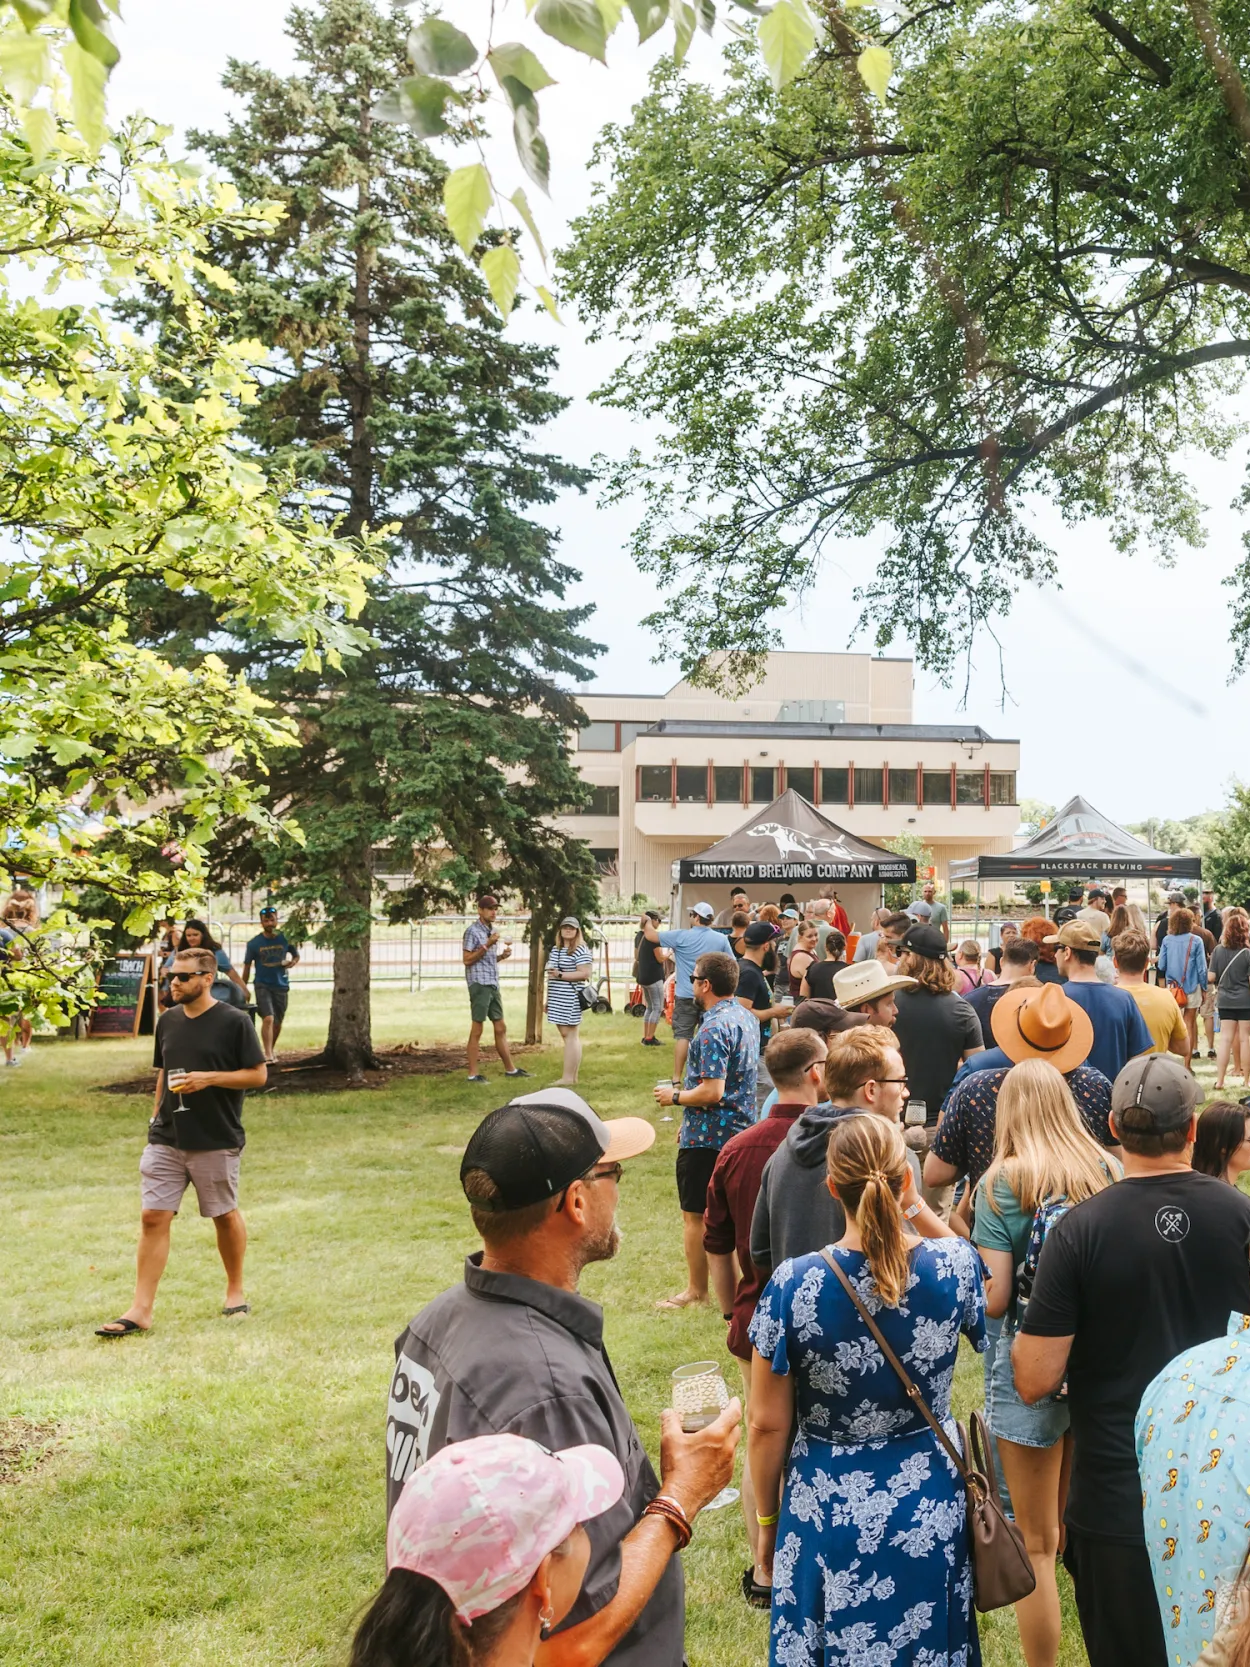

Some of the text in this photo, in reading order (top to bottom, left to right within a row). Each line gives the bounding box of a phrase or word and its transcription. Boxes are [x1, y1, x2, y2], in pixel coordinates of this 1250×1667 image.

[689, 863, 874, 878] JUNKYARD BREWING COMPANY
